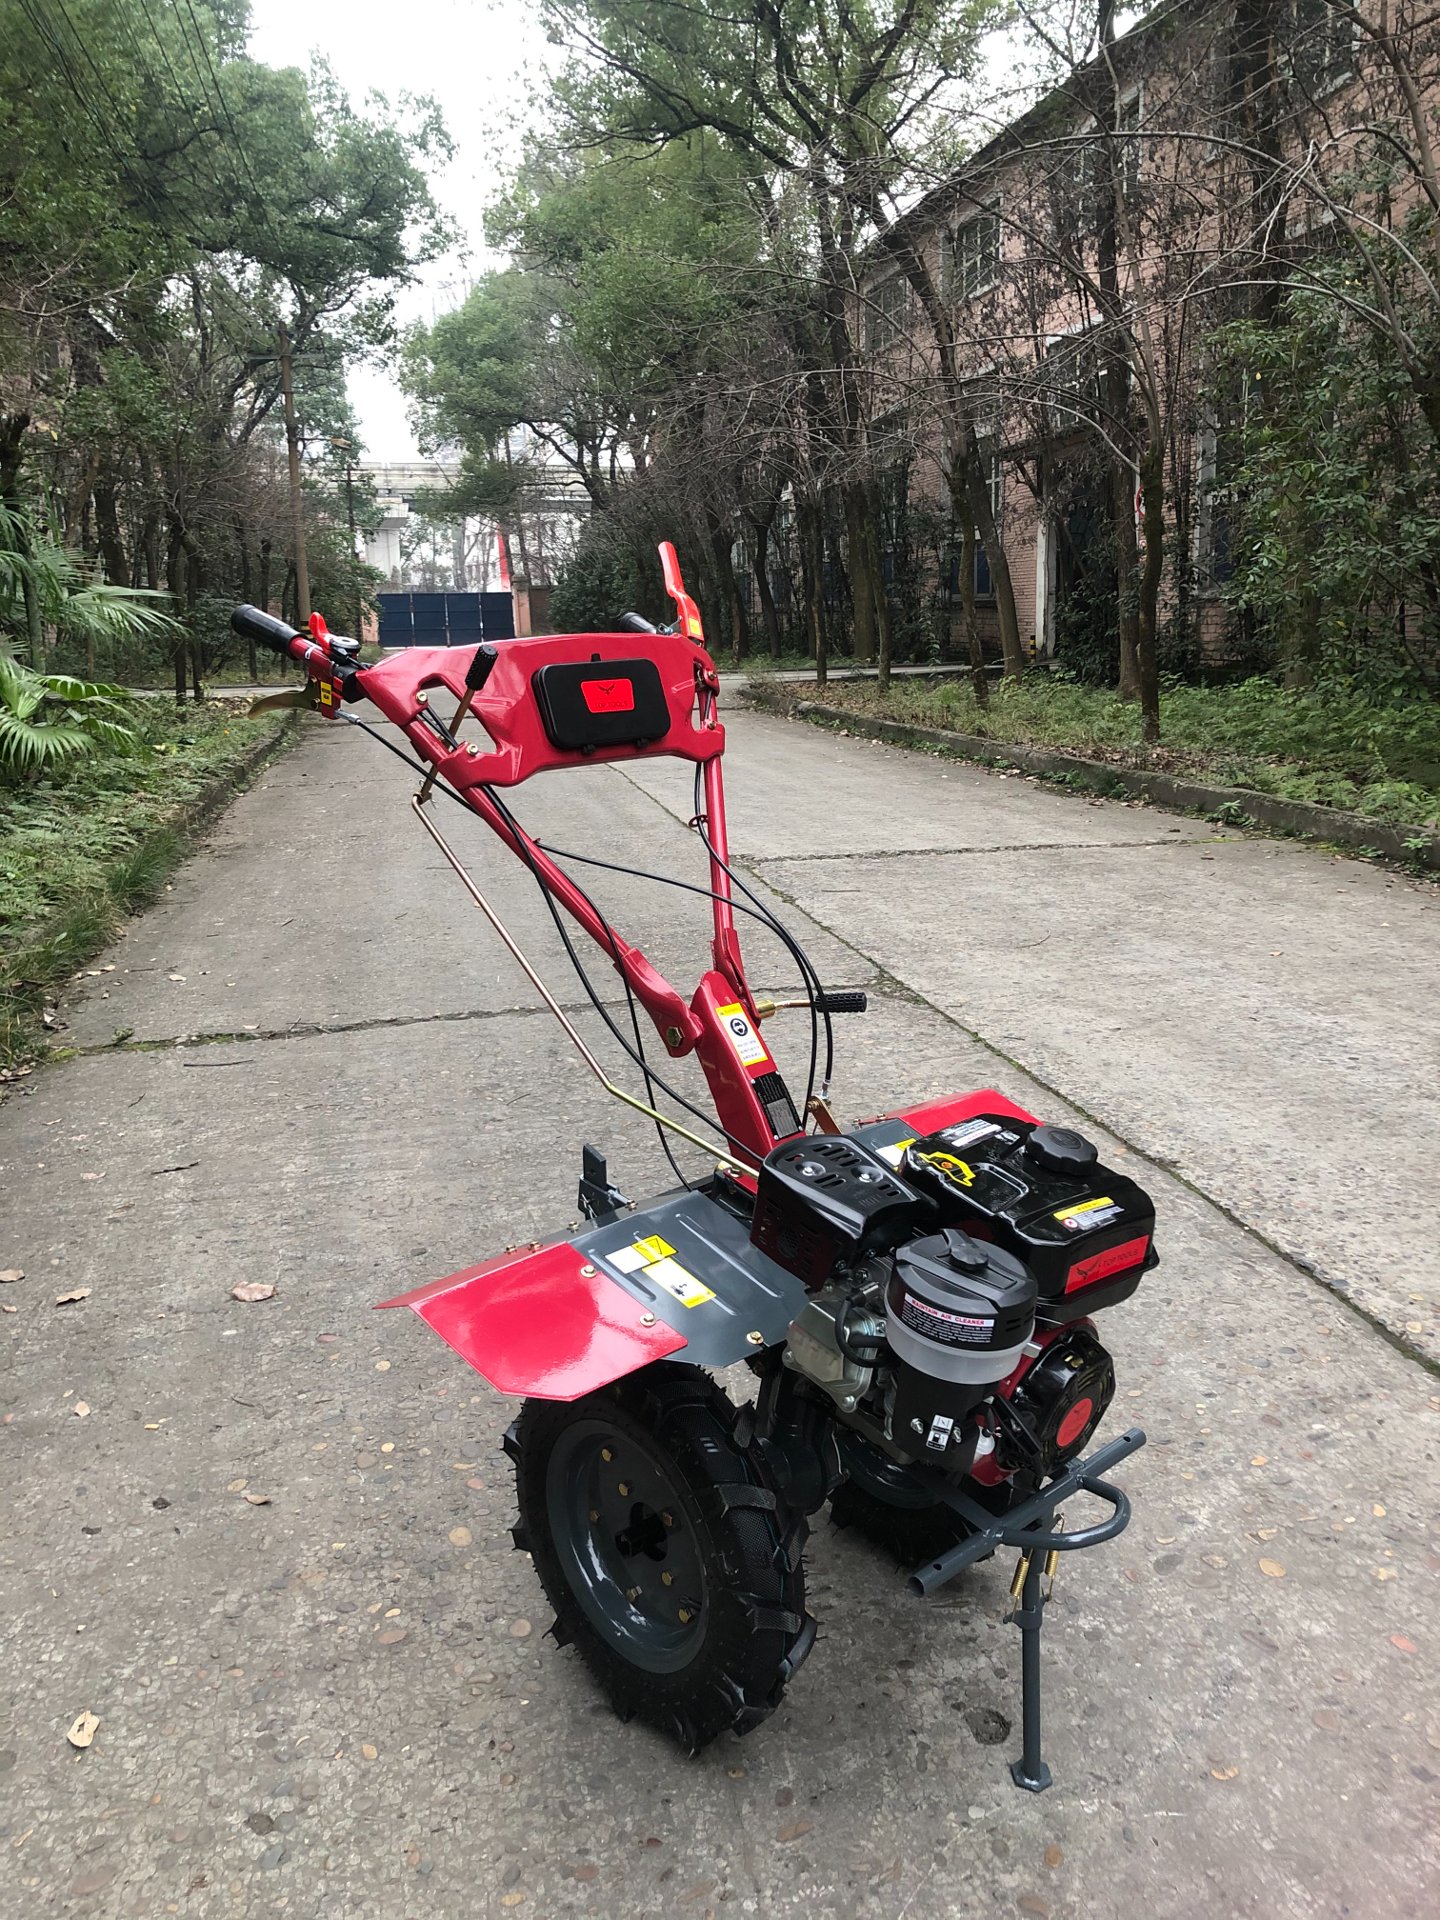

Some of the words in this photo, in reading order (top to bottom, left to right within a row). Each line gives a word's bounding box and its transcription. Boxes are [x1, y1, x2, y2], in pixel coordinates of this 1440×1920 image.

[911, 1298, 938, 1316] MAINTAIN
[941, 1313, 952, 1321] AIR
[954, 1316, 985, 1326] CLEANER
